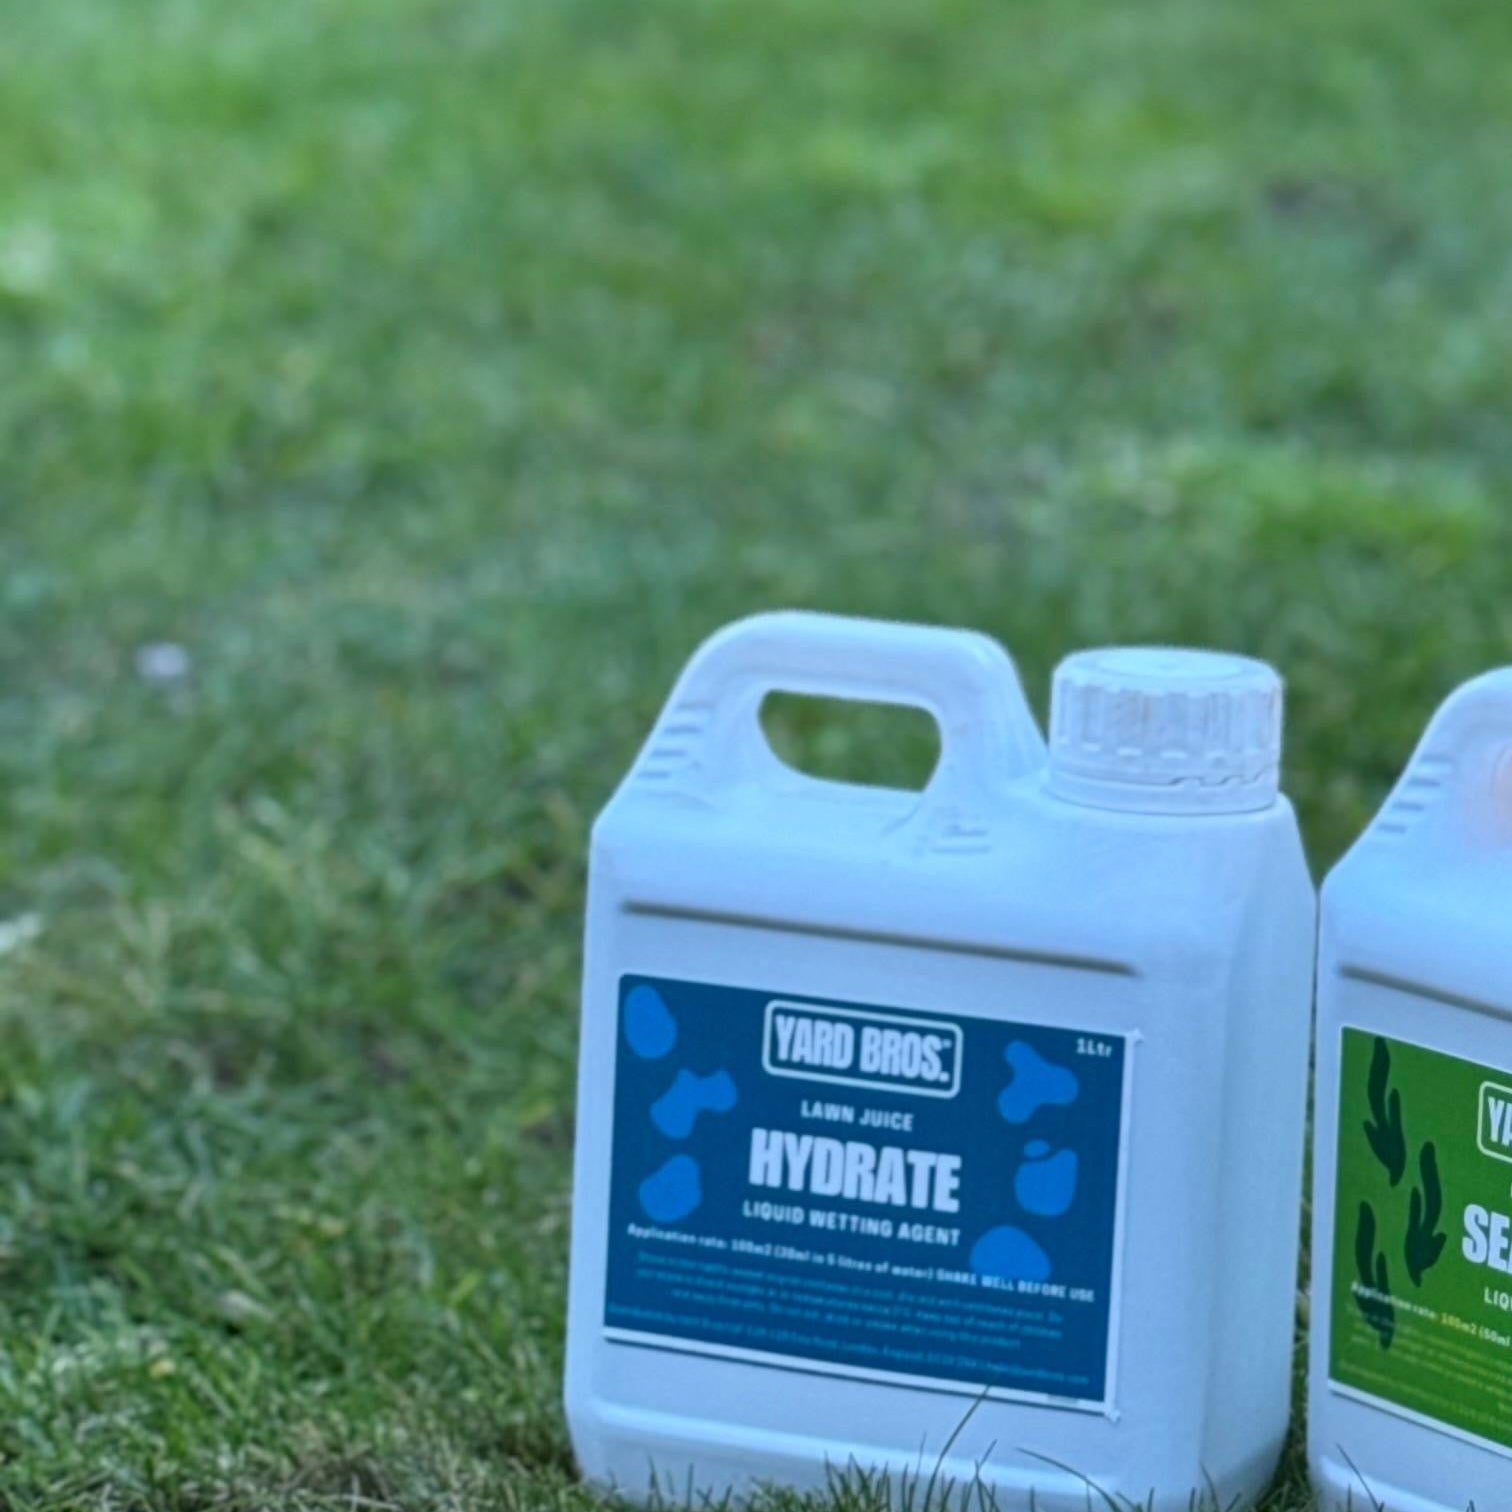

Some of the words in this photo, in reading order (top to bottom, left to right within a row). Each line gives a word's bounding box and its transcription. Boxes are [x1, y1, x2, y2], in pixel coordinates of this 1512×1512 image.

[774, 1014, 855, 1070] YARD
[1076, 1038, 1113, 1057] 1Ltr
[801, 1100, 855, 1124] LAWN
[859, 1108, 914, 1132] JUICE
[748, 1127, 962, 1214] HYDRATE
[742, 1200, 805, 1225] LIQUID
[809, 1207, 893, 1238] WETTING
[897, 1222, 961, 1246] AGENT
[627, 1222, 697, 1245] Application
[936, 1268, 978, 1286] SHAKE
[980, 1274, 1015, 1292] WELL
[1017, 1279, 1067, 1300] BEFORE
[1069, 1287, 1096, 1303] USE
